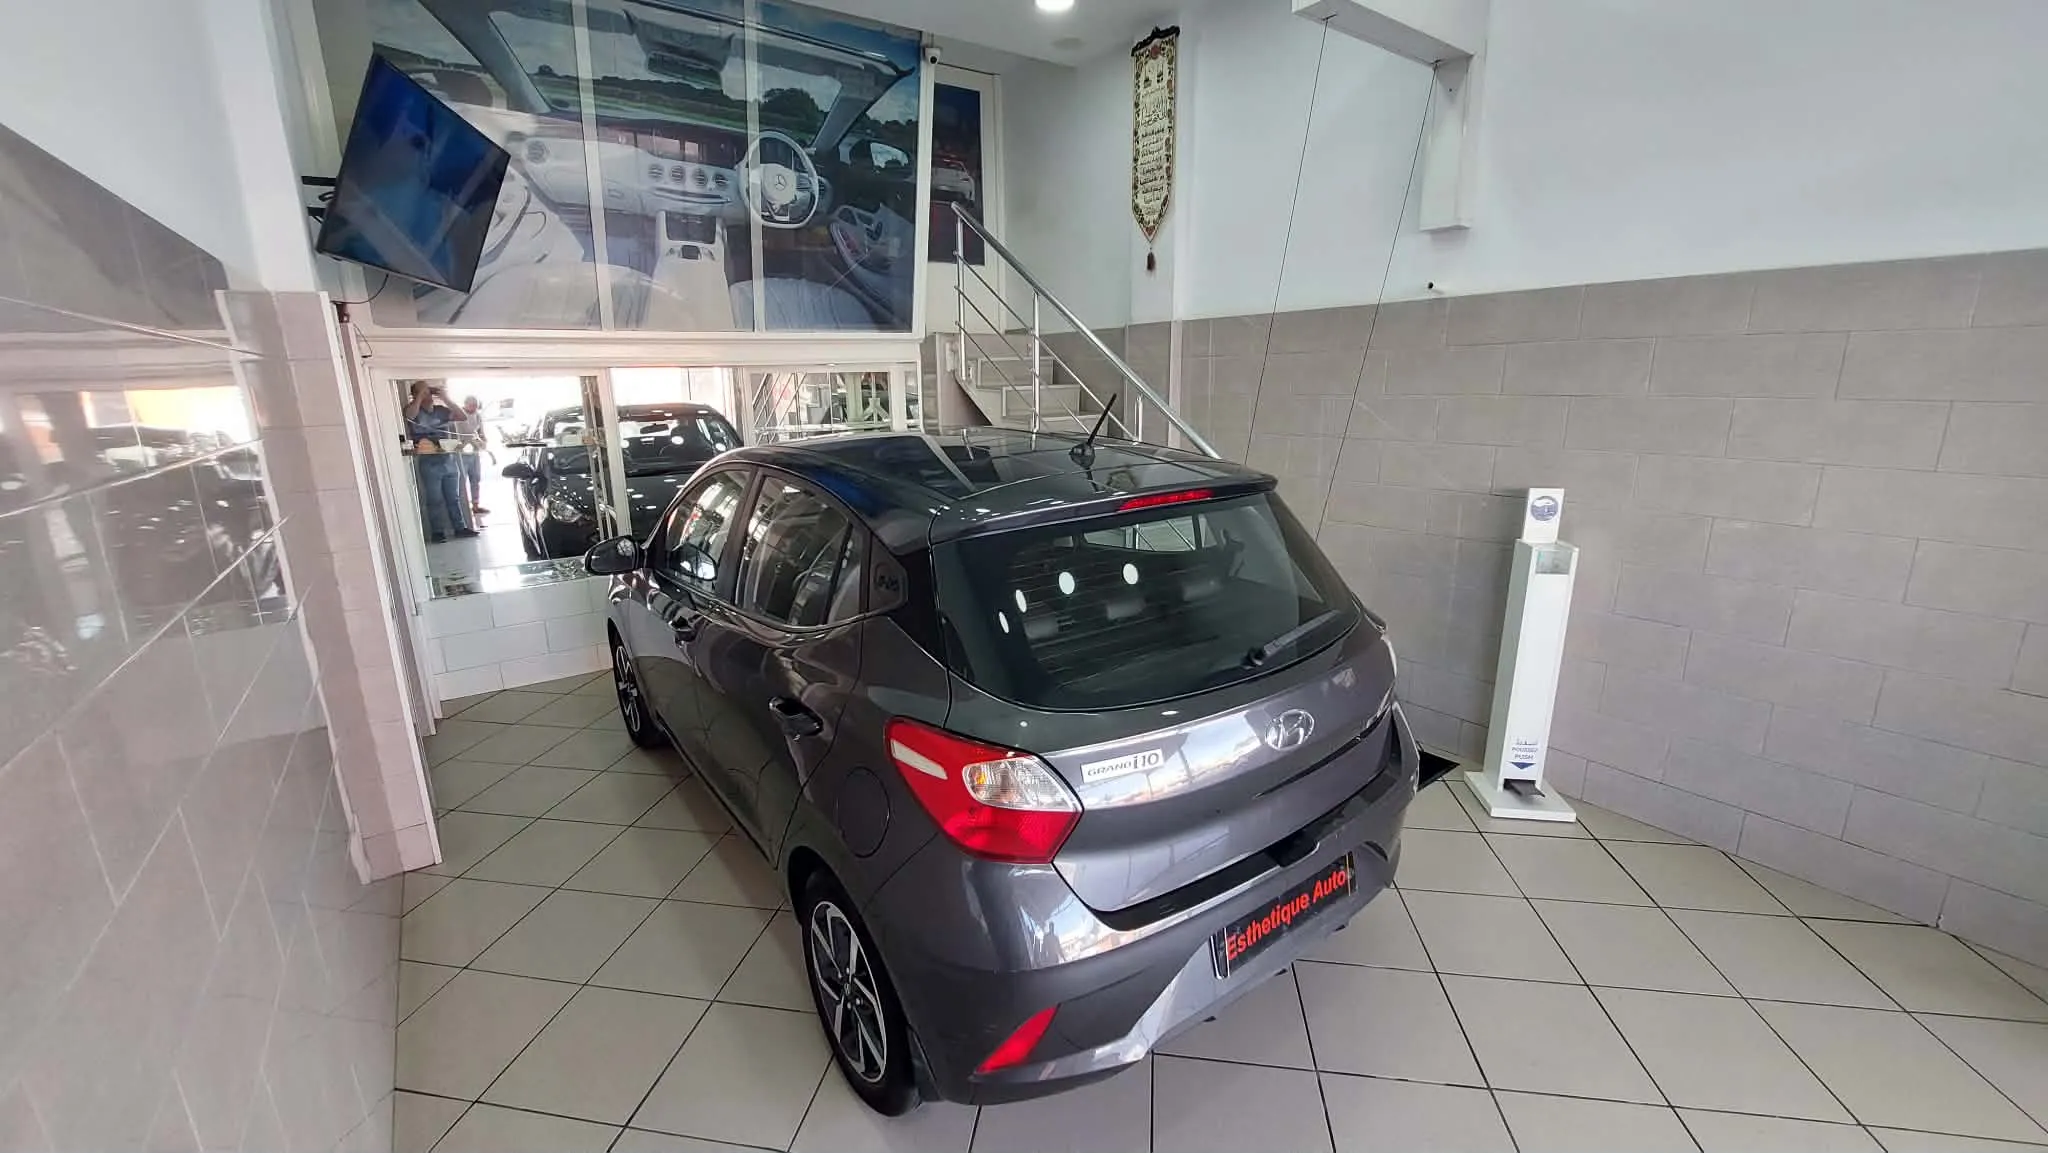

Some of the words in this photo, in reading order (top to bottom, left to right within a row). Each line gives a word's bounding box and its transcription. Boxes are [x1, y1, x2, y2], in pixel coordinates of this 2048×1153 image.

[1087, 761, 1132, 776] GRAND
[1133, 752, 1160, 769] i10
[1227, 893, 1310, 961] Esthetique
[1312, 870, 1346, 903] Auto
